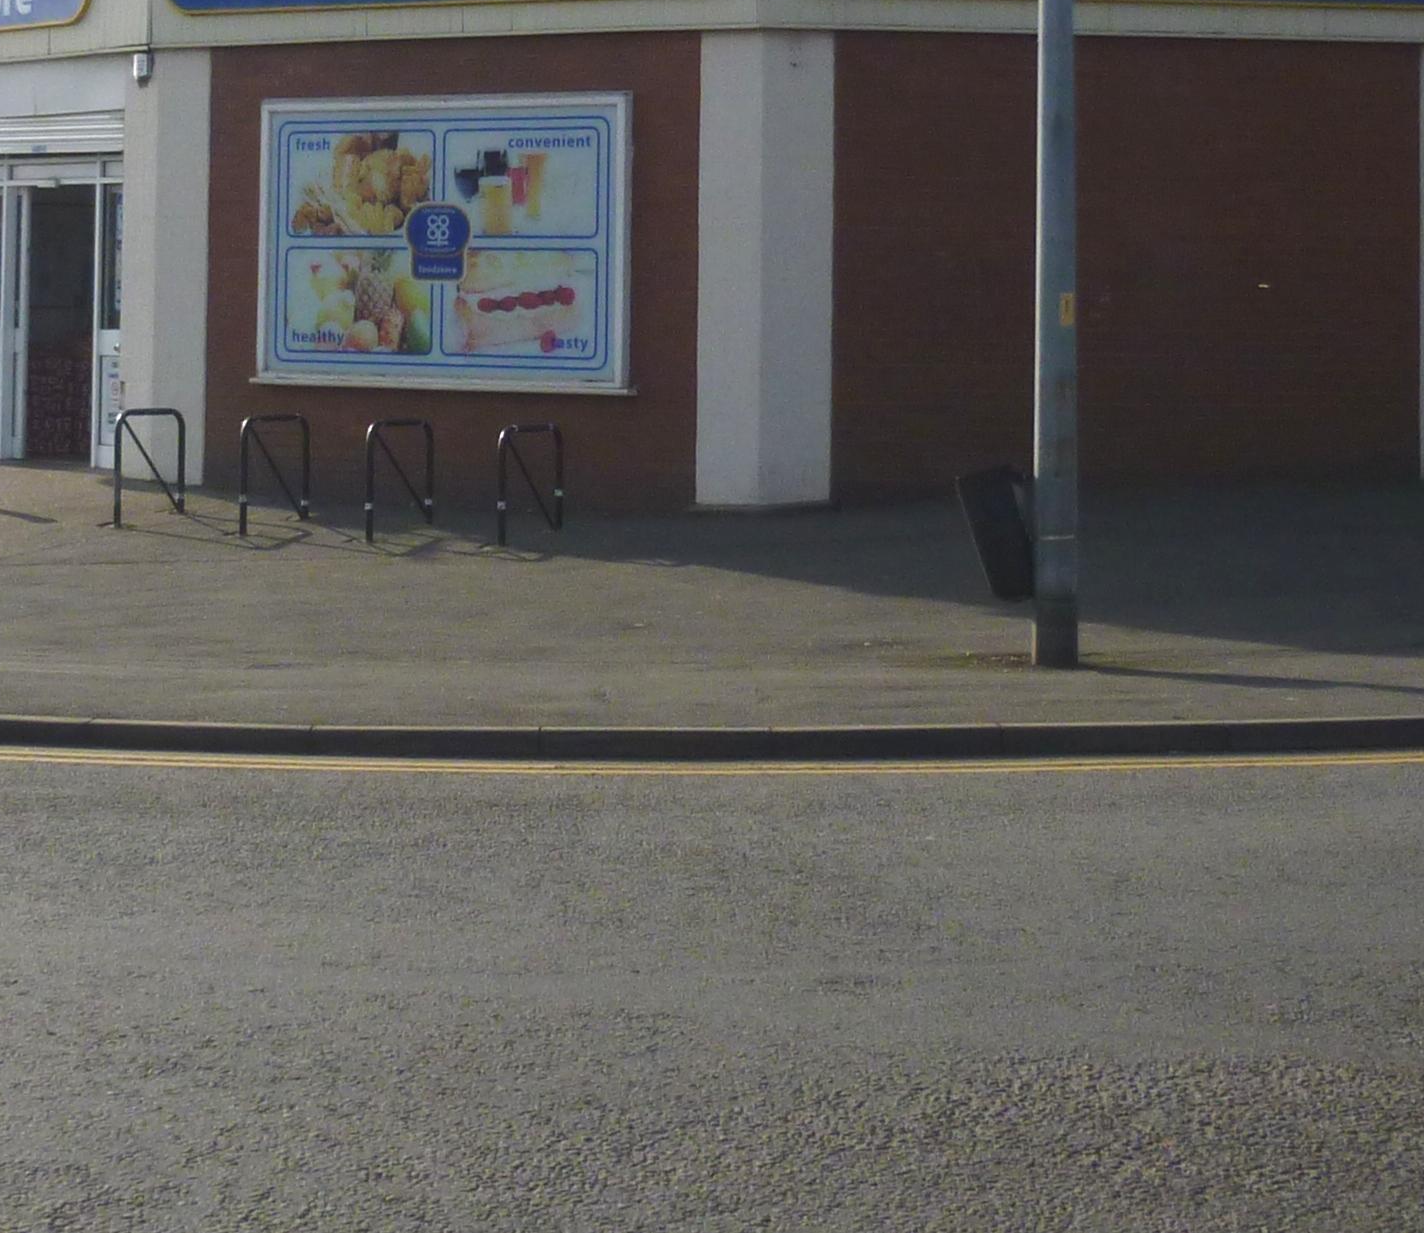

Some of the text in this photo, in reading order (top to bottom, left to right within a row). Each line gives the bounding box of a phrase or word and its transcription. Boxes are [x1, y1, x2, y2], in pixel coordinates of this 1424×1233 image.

[295, 137, 330, 152] fresh
[508, 134, 592, 149] convenient
[292, 329, 345, 346] healthy
[551, 336, 589, 353] tasty
